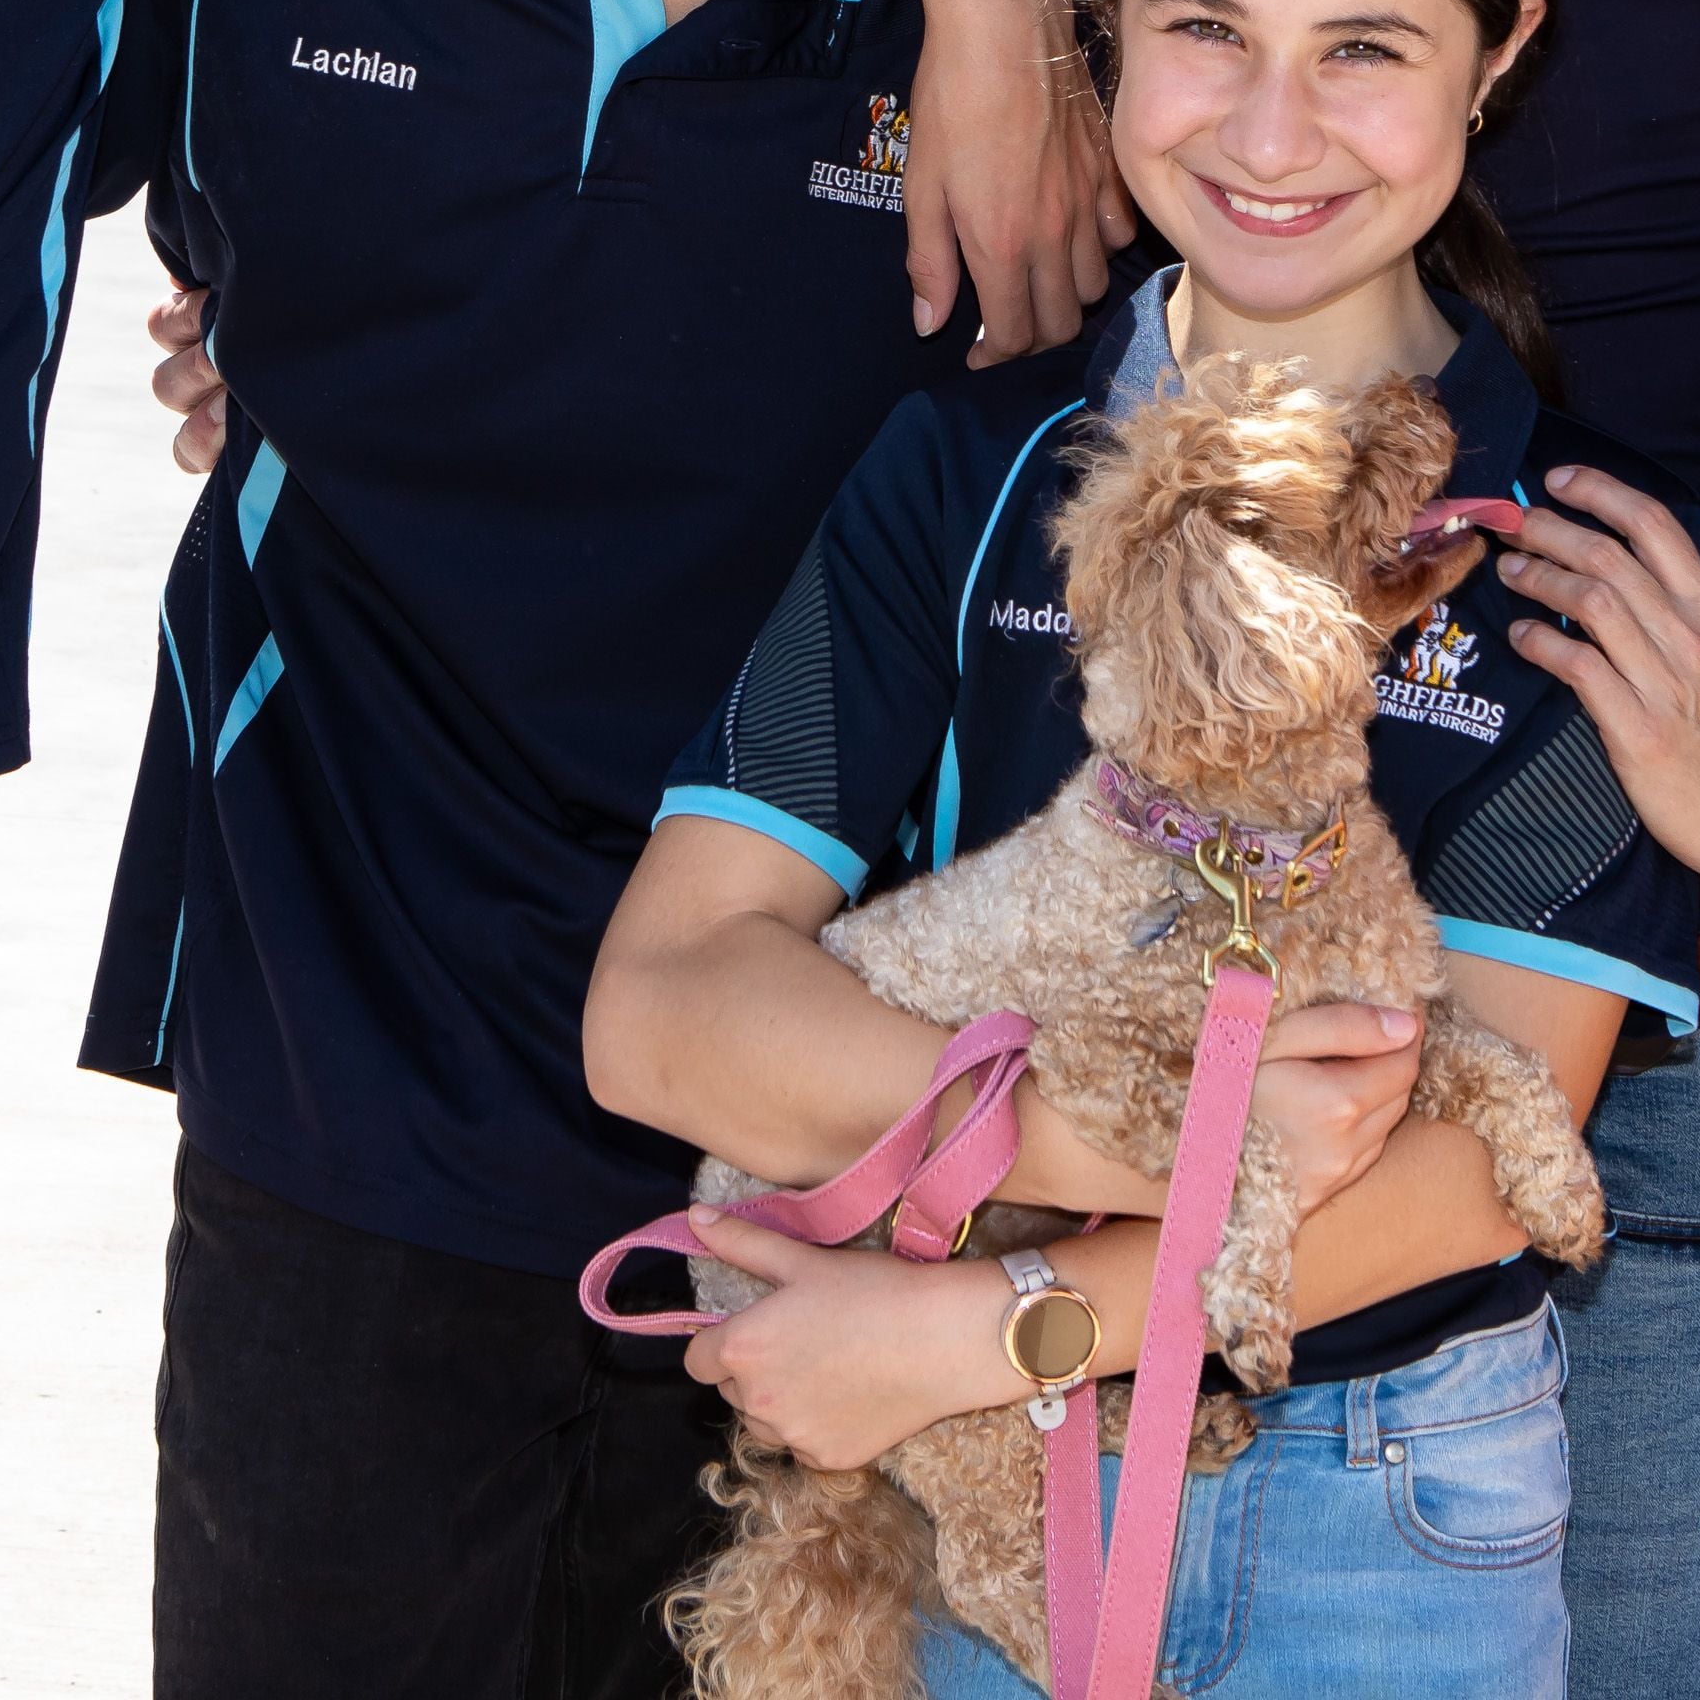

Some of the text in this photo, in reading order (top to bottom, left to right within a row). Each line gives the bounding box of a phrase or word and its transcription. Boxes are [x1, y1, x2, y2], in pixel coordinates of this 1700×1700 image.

[291, 36, 417, 91] Lachlan
[808, 183, 885, 210] VETERINARY
[809, 160, 903, 198] HIGHFIE
[989, 599, 1083, 642] Madd
[1373, 674, 1506, 728] GHFIELDS
[1429, 710, 1500, 745] SURGERY
